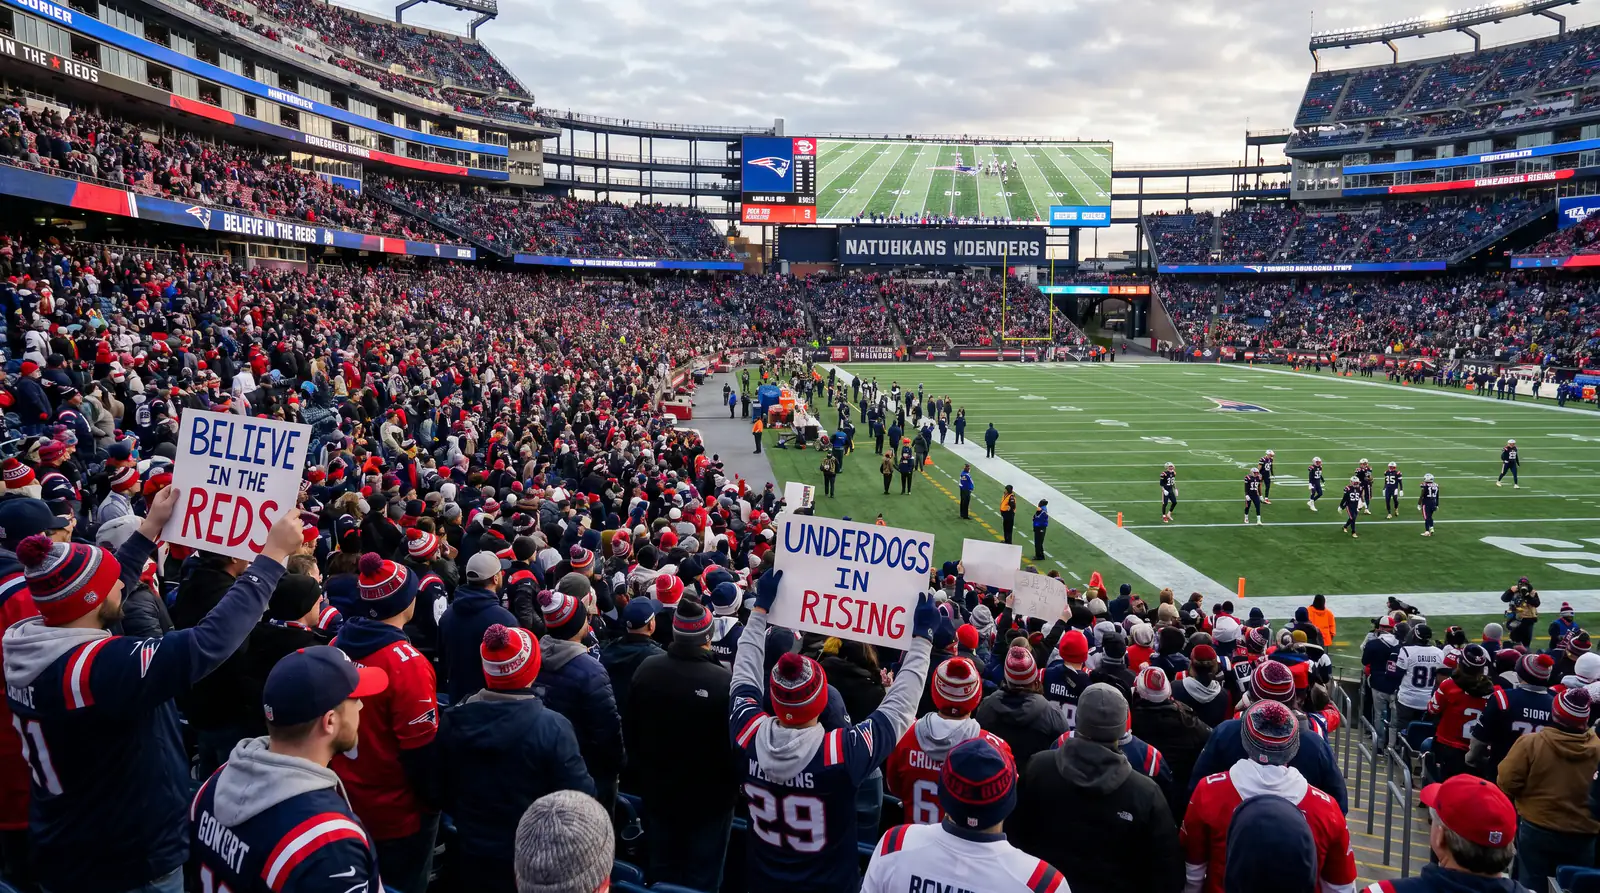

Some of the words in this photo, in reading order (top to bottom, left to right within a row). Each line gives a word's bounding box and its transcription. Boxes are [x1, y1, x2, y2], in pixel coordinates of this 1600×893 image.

[23, 46, 47, 66] THE
[64, 60, 99, 83] REDS
[224, 213, 264, 236] BELIEVE
[265, 224, 275, 238] IN
[276, 223, 293, 241] THE
[295, 226, 317, 243] REDS
[804, 209, 811, 219] 3
[189, 416, 301, 470] BELIEVE
[206, 464, 232, 487] IN
[238, 469, 269, 493] THE
[181, 486, 279, 554] REDS
[784, 521, 931, 574] UNDERDOGS
[834, 567, 870, 593] IN
[800, 589, 906, 640] RISING
[393, 643, 420, 663] 11
[744, 783, 827, 852] 29
